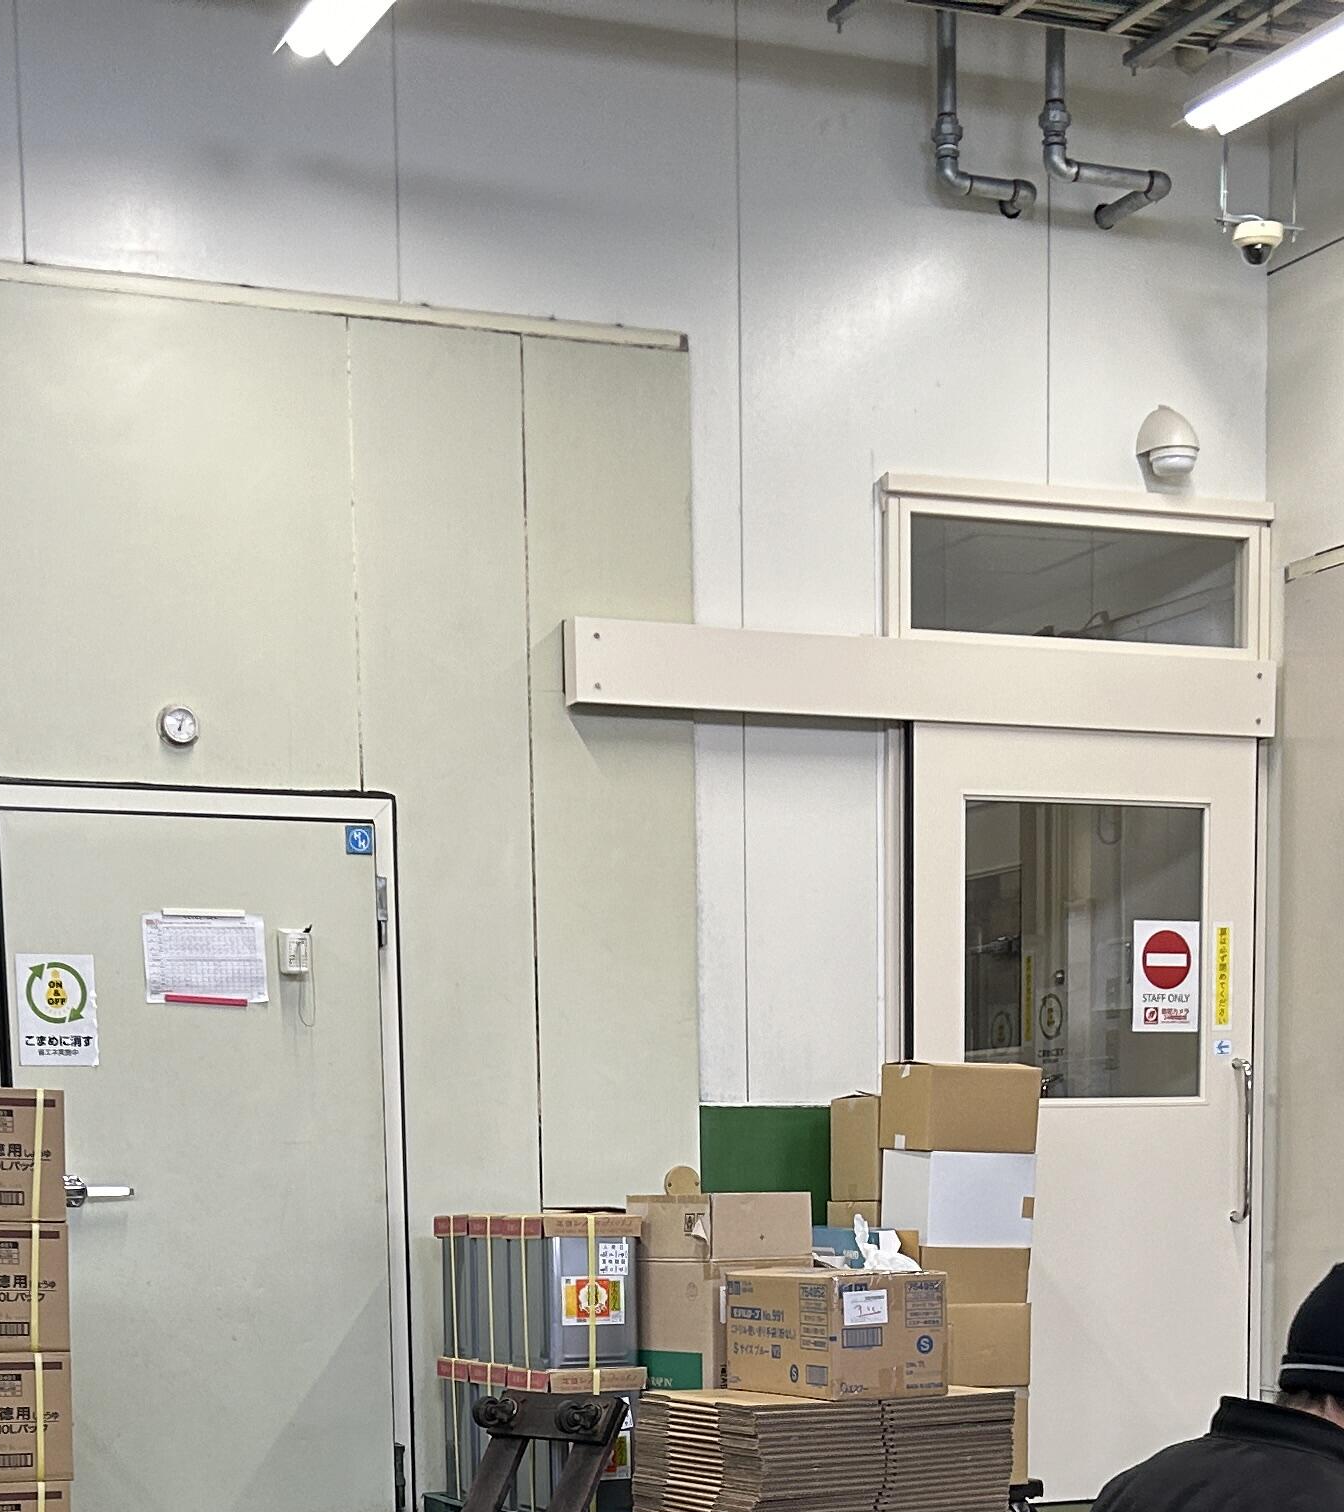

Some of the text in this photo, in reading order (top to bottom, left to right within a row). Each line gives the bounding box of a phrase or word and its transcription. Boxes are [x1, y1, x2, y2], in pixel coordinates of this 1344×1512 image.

[1142, 994, 1190, 1003] STAFF ONLY
[25, 1035, 93, 1047] こまめに消す
[920, 1338, 931, 1353] S
